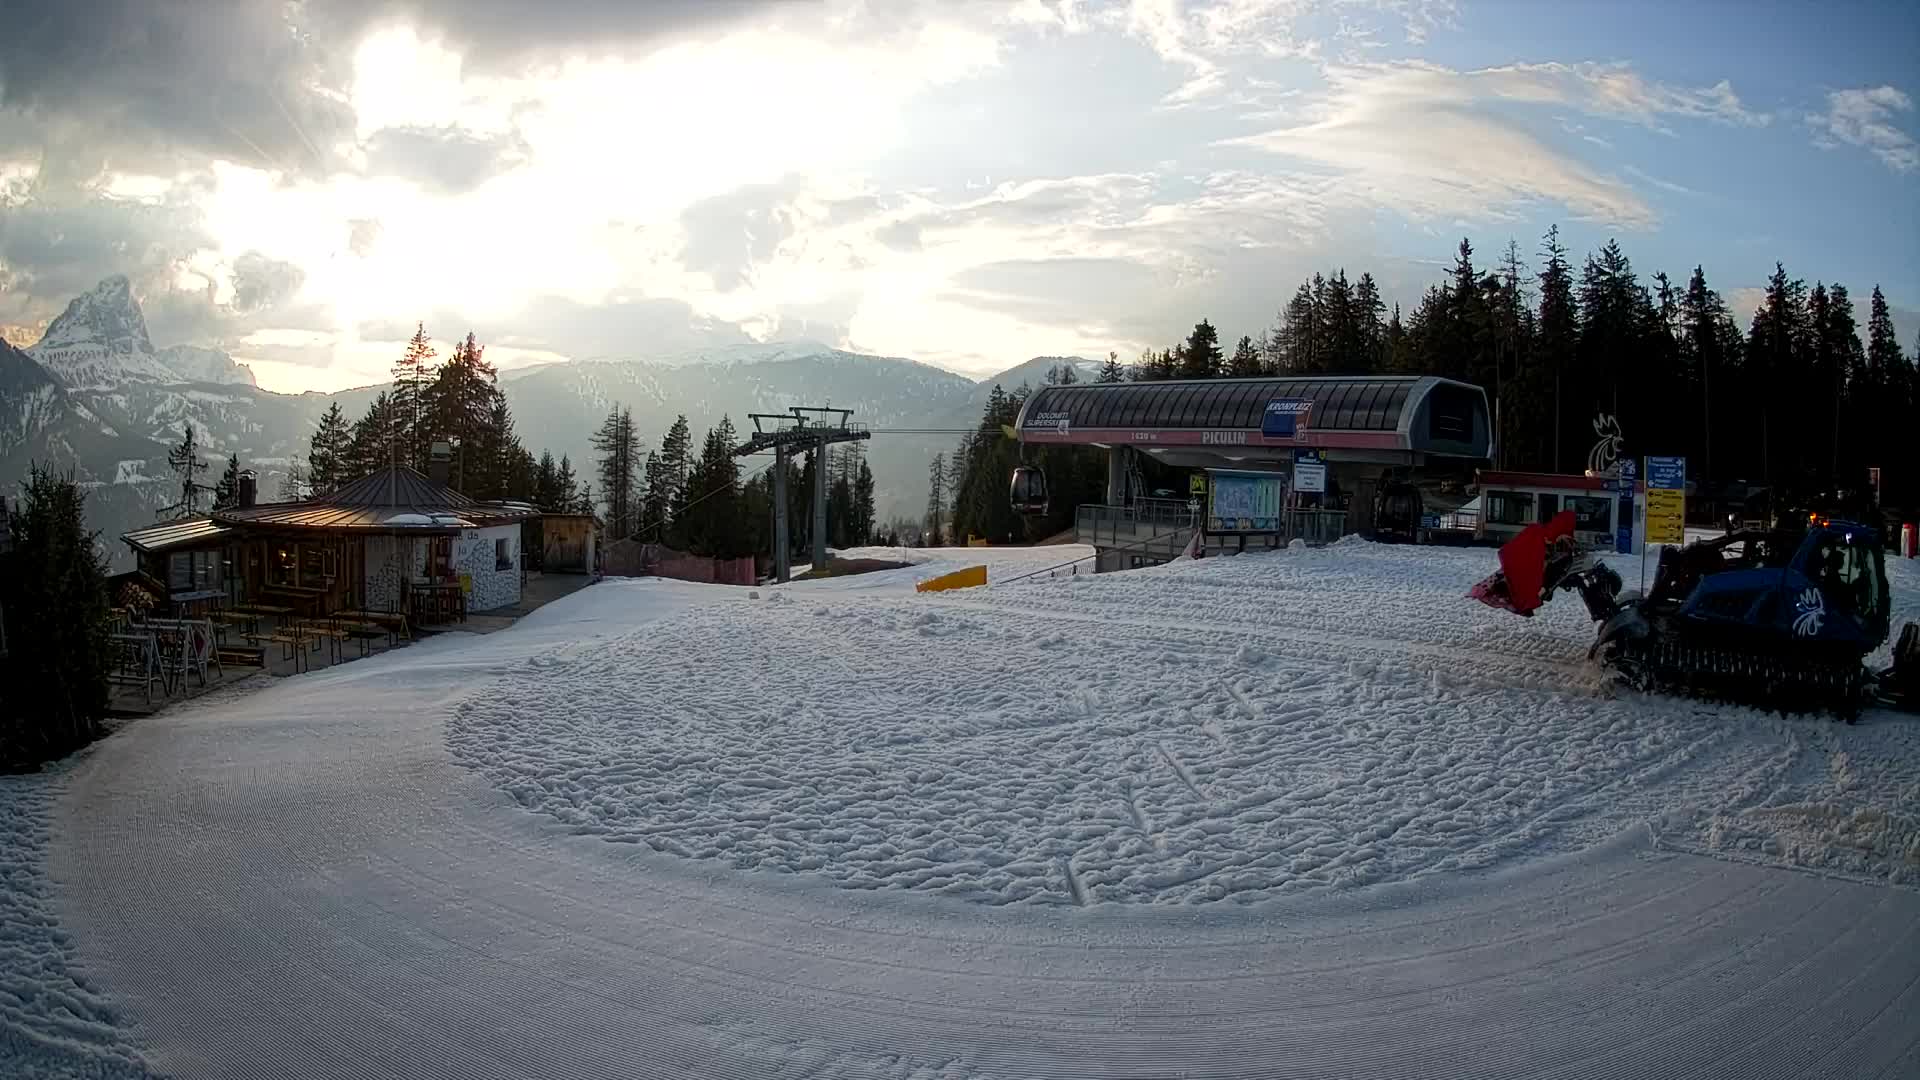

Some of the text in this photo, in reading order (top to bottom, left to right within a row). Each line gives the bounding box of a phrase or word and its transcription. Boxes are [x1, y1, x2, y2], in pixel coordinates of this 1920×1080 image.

[1266, 402, 1313, 411] KRONPLATZ
[1037, 411, 1069, 419] DOLOMITI
[1026, 419, 1059, 427] SUPERSKI
[1202, 431, 1247, 445] PICULIN
